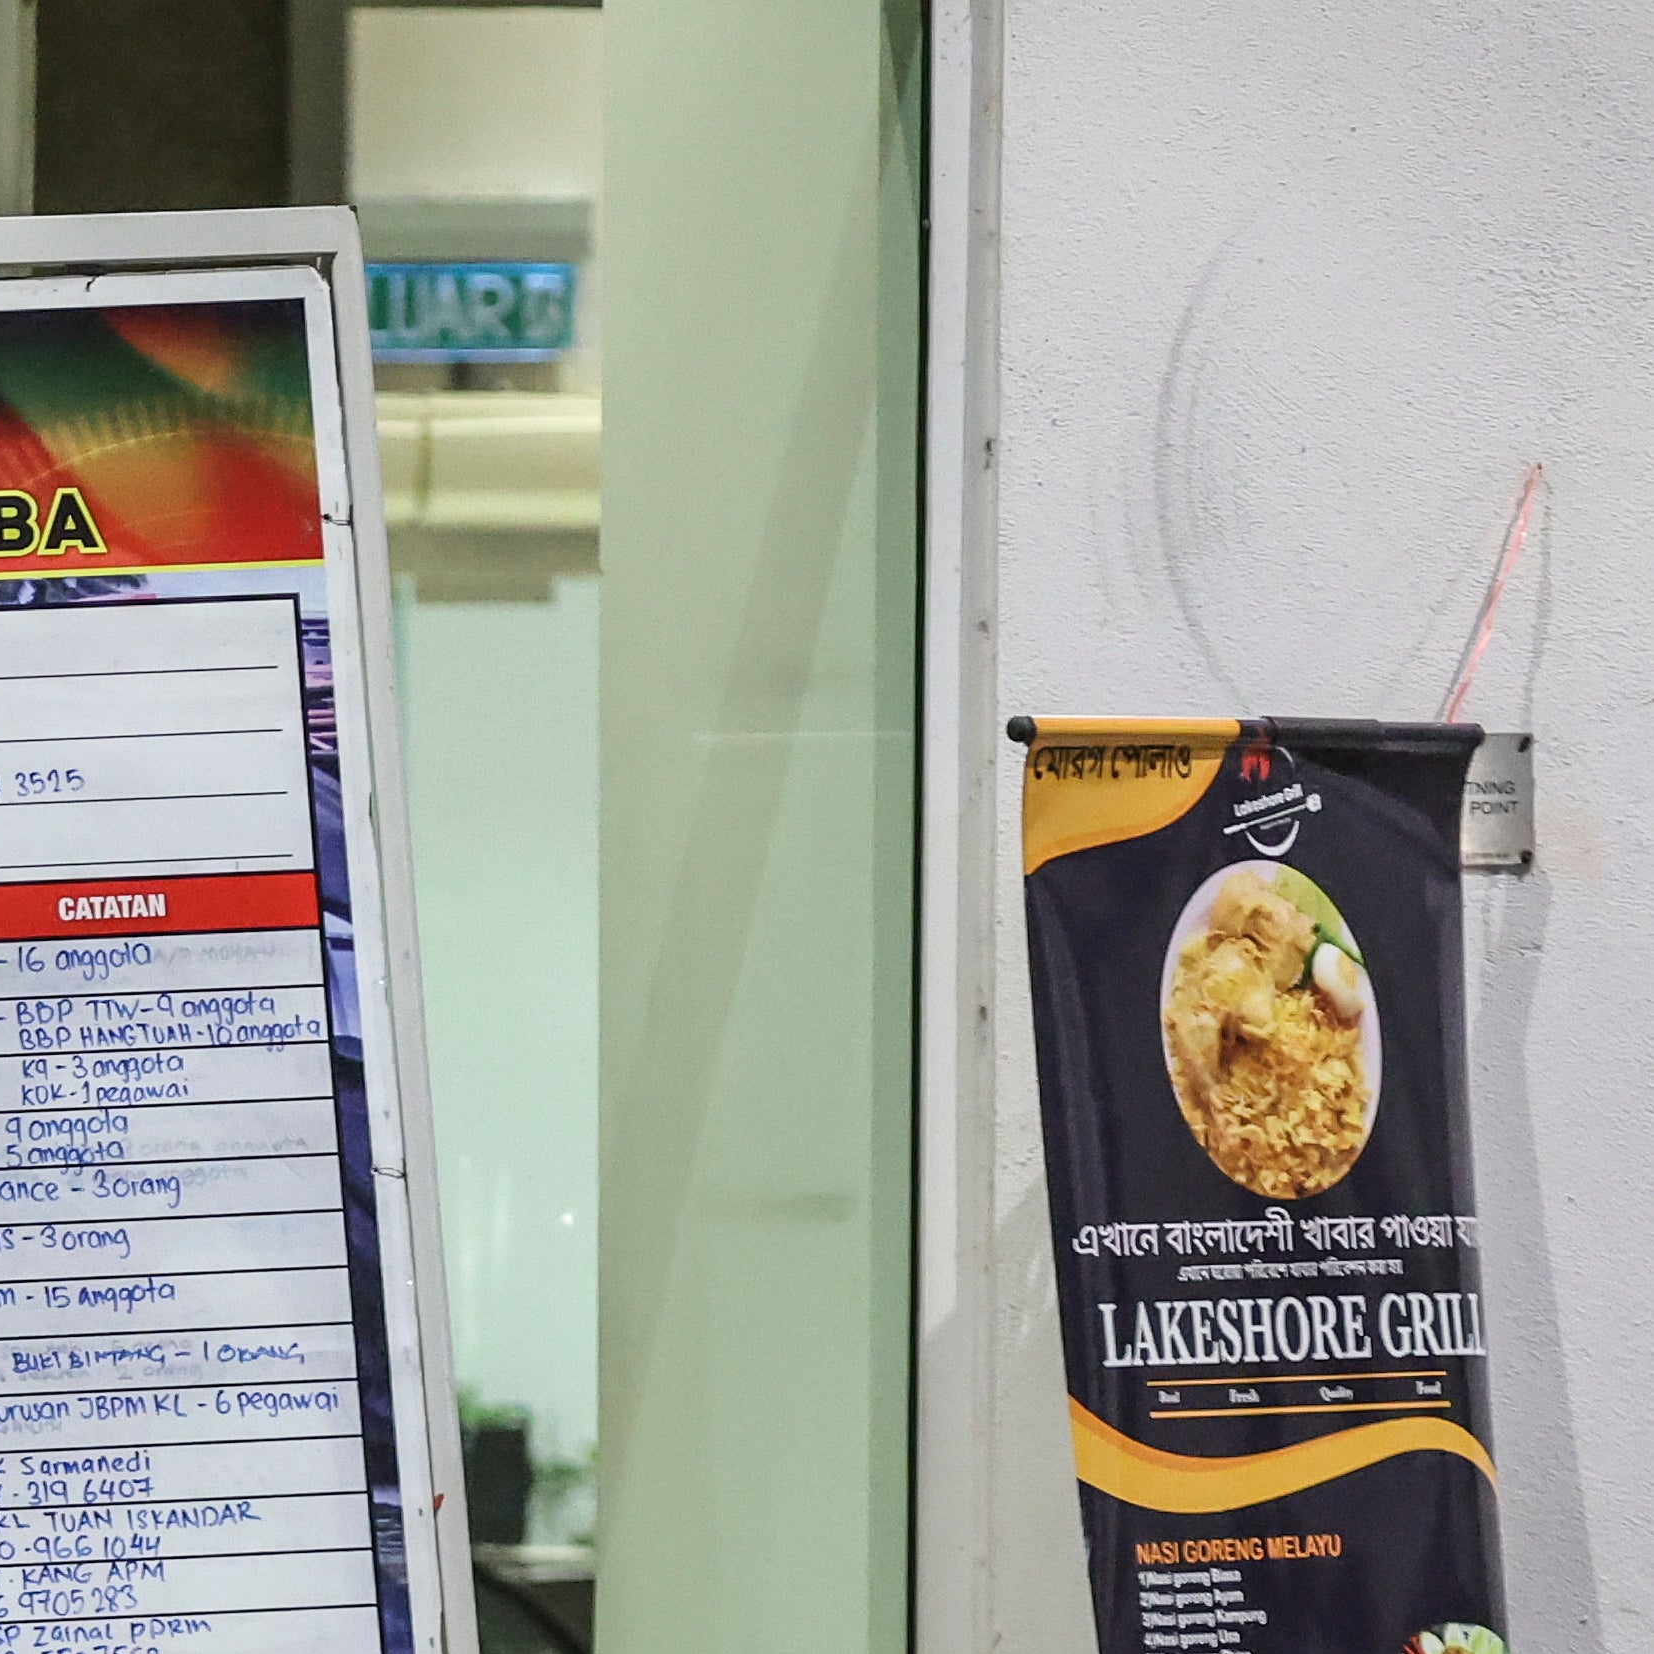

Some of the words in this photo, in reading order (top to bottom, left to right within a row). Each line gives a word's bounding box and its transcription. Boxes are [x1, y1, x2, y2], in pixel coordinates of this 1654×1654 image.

[15, 769, 85, 796] 3525
[59, 894, 165, 920] CATATAN
[56, 942, 151, 981] anggota
[181, 991, 275, 1025] anggota
[29, 1116, 128, 1147] anggota
[78, 1277, 175, 1314] anggota
[1097, 1296, 1373, 1368] LAKESHORE
[154, 1394, 187, 1417] KL
[237, 1392, 338, 1417] pegawai
[49, 1509, 112, 1533] TUAN
[127, 1501, 260, 1530] ISKANDAR
[1136, 1542, 1179, 1564] NASI
[1184, 1538, 1264, 1562] GORENG
[1267, 1534, 1342, 1558] MELAYU
